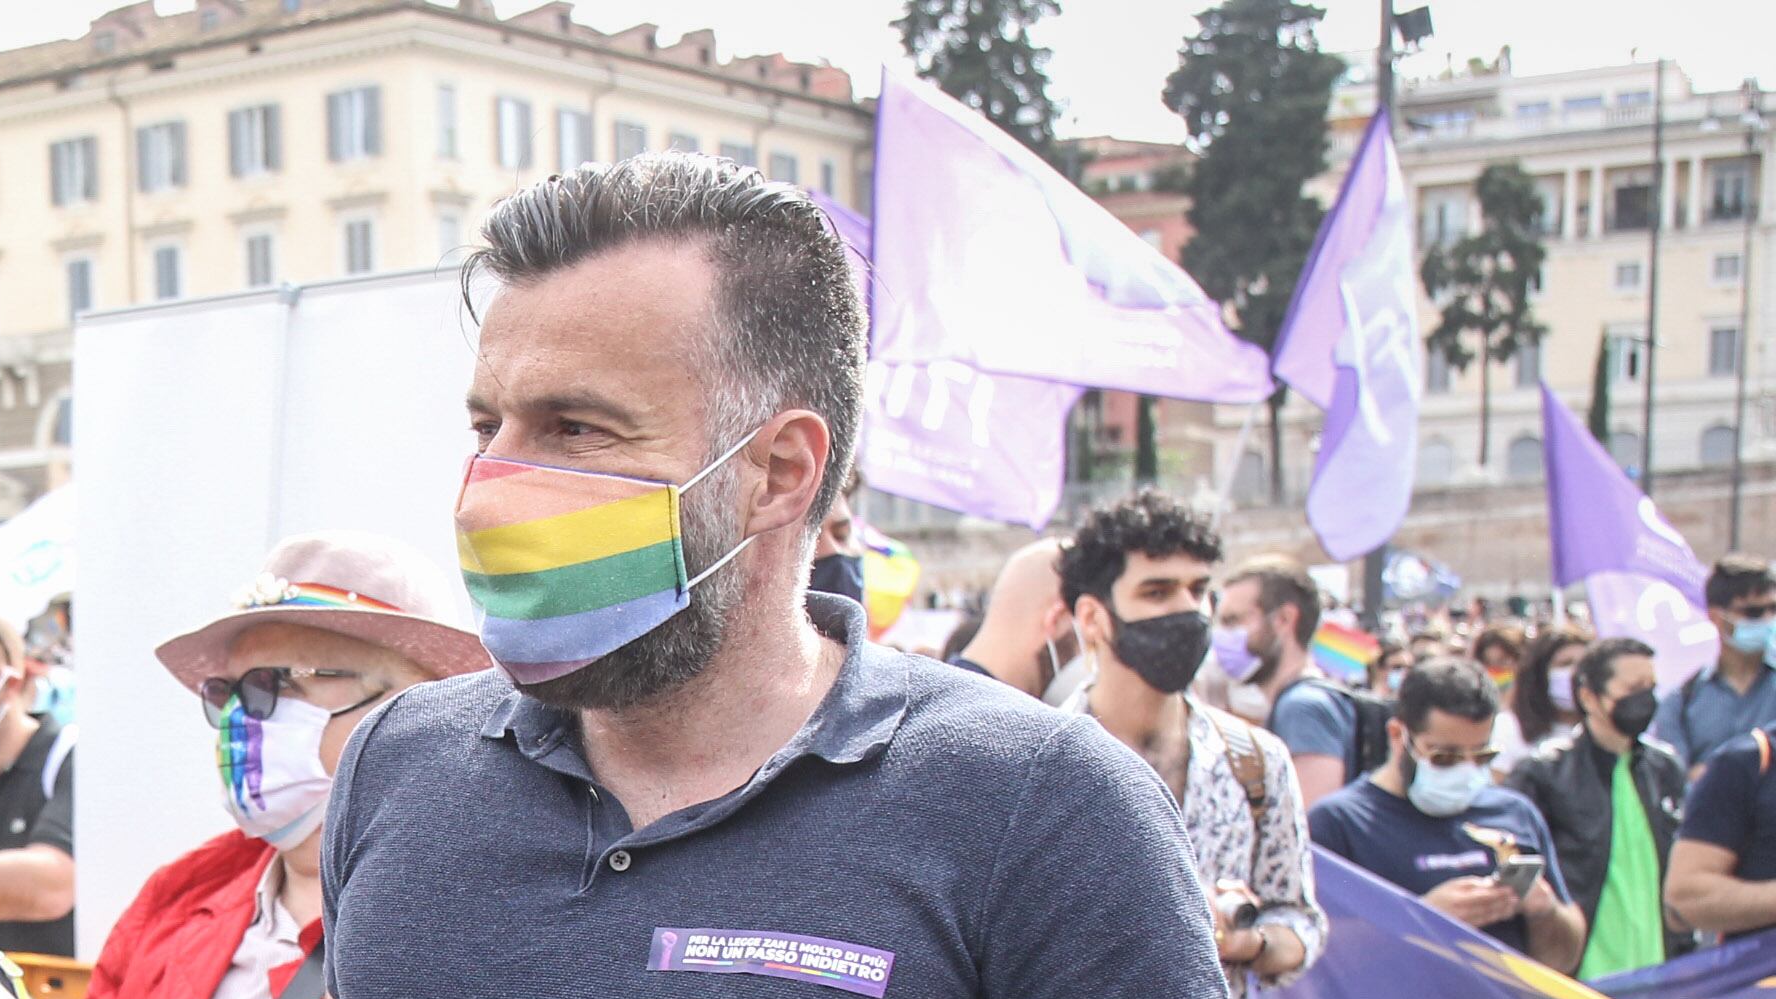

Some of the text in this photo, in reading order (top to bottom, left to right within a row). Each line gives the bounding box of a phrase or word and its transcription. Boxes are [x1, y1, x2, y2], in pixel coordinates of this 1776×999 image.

[685, 945, 886, 982] NON UN PASSO INDIETRO
[688, 935, 709, 945] PER
[710, 936, 726, 947] LA
[727, 937, 761, 948] LEGGE
[762, 938, 788, 950] ZAN
[789, 941, 798, 951] E
[799, 942, 842, 959] MOLTO
[844, 950, 860, 963] DI
